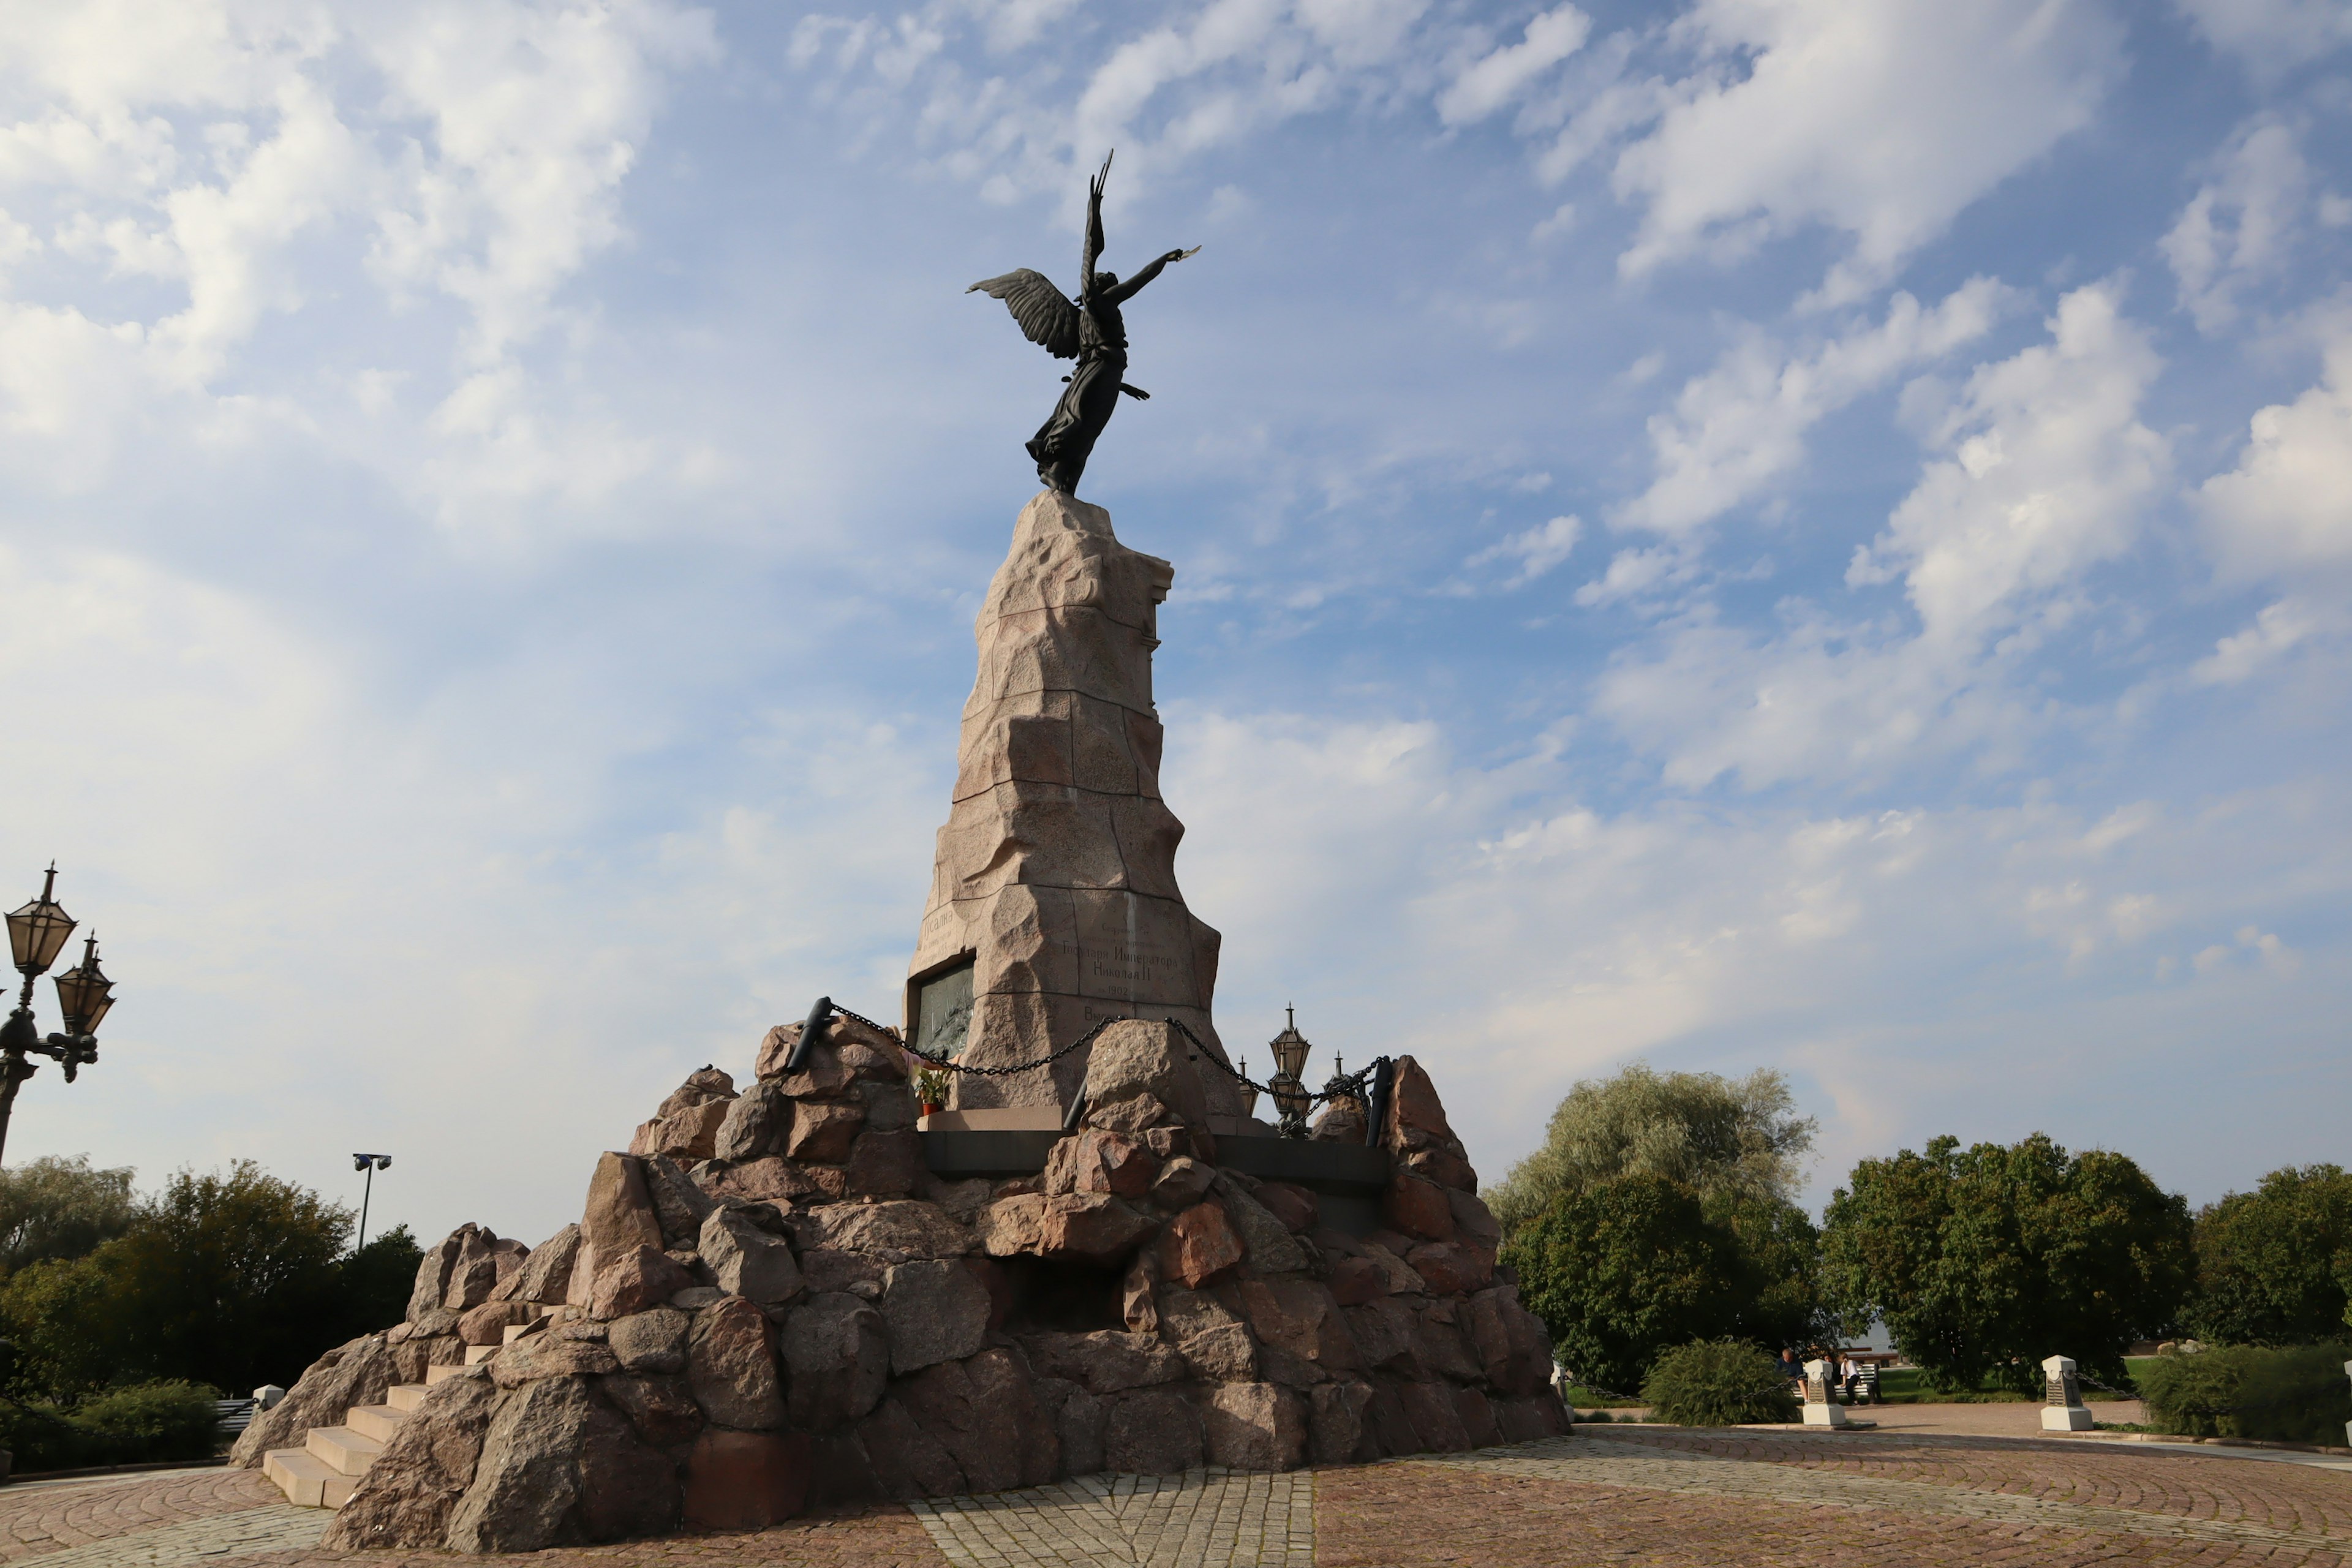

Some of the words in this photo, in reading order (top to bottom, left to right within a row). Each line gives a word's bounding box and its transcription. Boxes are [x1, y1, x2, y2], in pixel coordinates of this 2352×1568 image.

[1114, 946, 1178, 970] Императора
[1093, 961, 1139, 981] Николая
[1108, 986, 1128, 995] 1902
